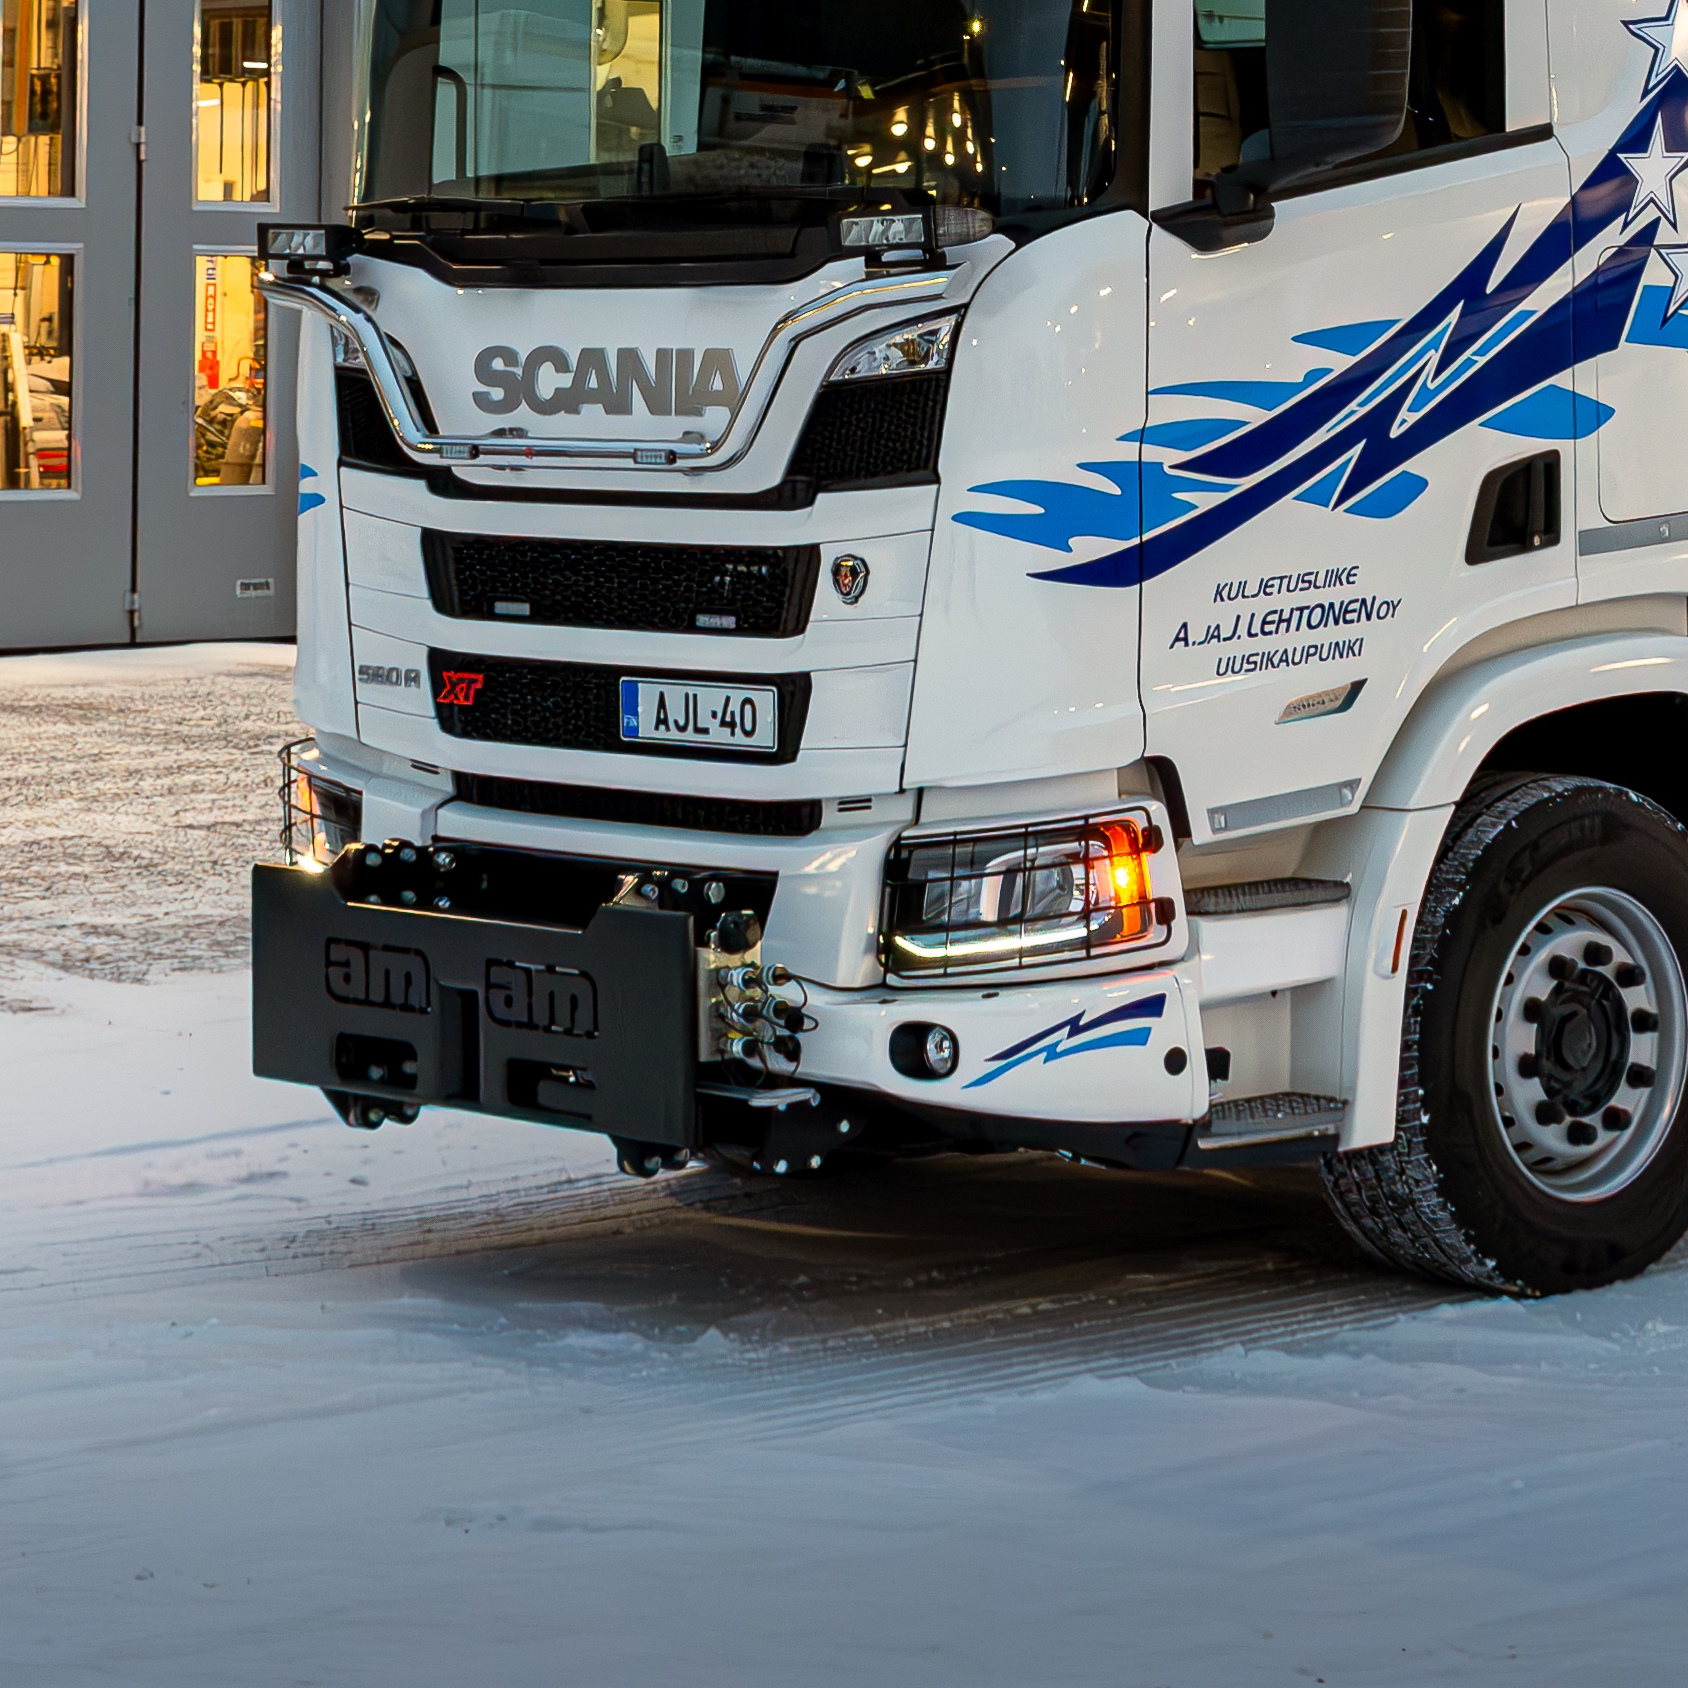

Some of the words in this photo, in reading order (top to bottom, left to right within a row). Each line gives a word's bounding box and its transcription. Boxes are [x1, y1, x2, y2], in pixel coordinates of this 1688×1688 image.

[472, 344, 742, 417] SCANIA
[1213, 565, 1360, 604] KULJETUSLIIKE
[1246, 595, 1377, 639] LEHTONEN
[1377, 598, 1403, 621] OY
[1215, 637, 1364, 677] UUSIKAUPUNKI
[437, 671, 484, 705] XT
[653, 690, 757, 739] AJL-40
[325, 937, 431, 1014] am
[485, 957, 600, 1039] am
